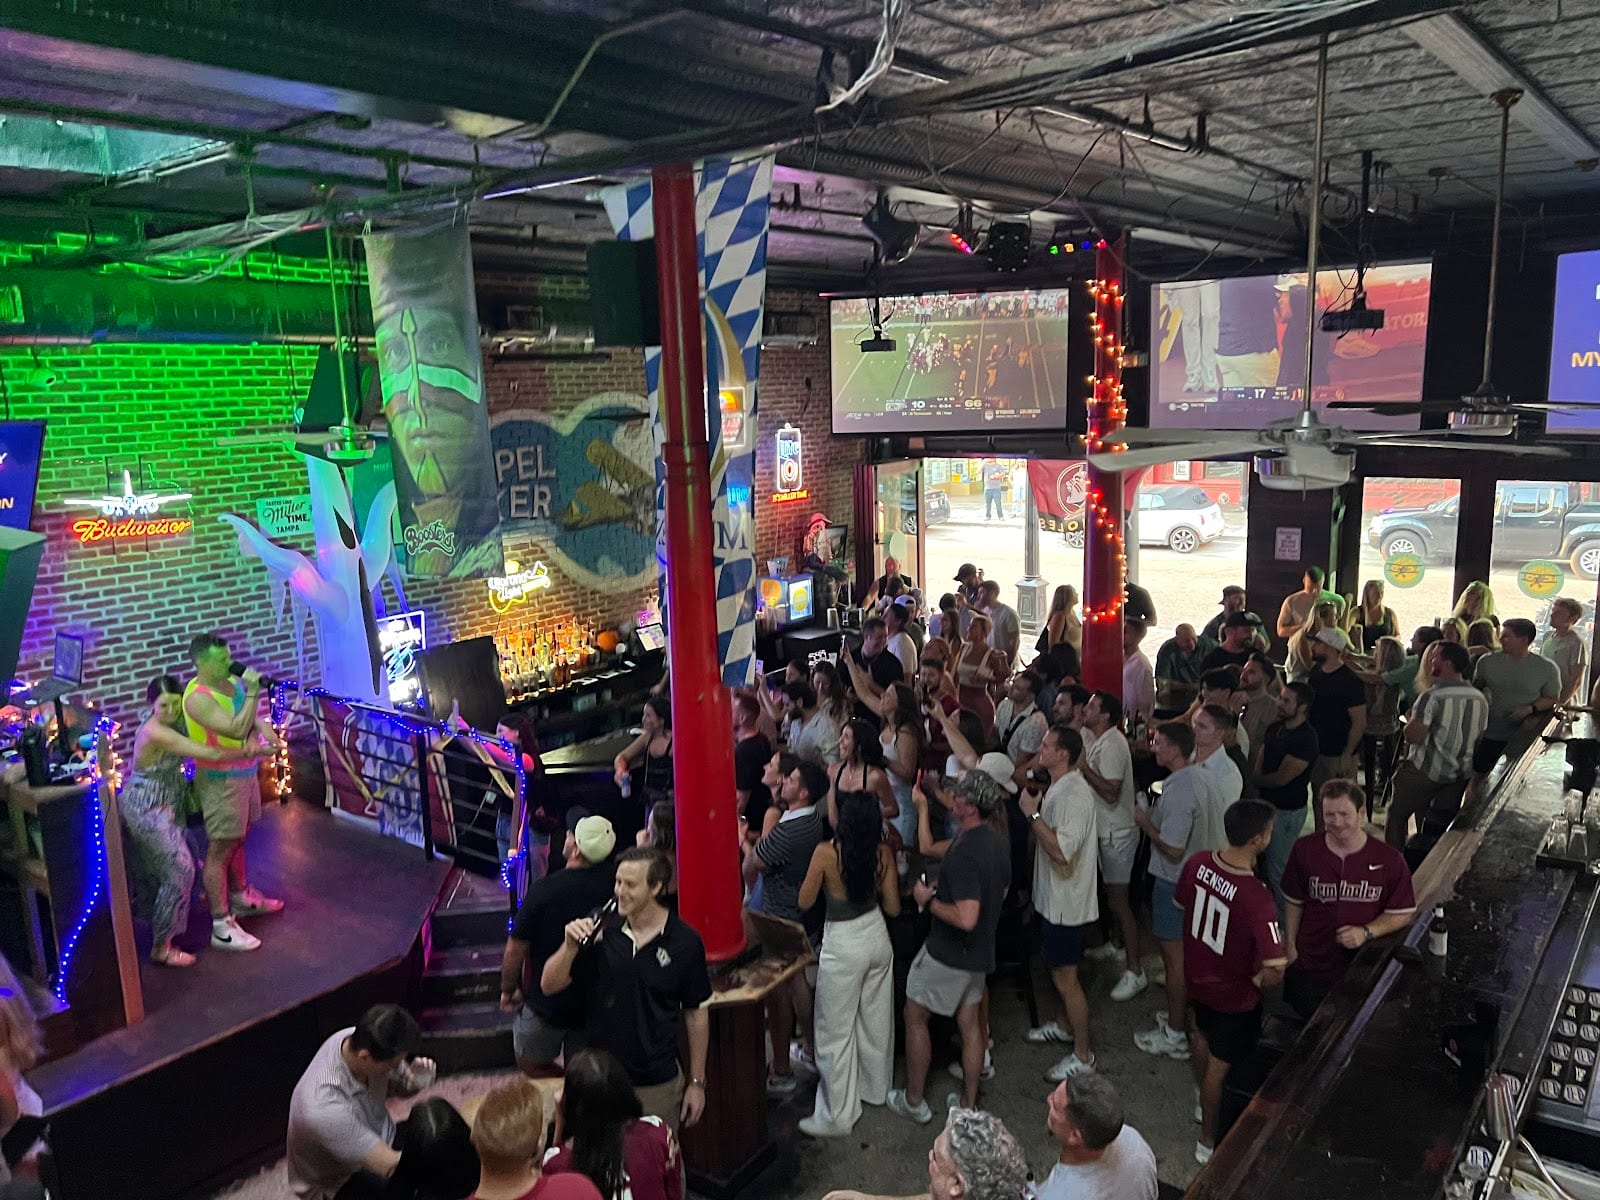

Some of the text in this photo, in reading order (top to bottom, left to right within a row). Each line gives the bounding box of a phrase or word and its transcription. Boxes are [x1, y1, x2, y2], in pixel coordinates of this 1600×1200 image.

[911, 400, 926, 409] 10
[1254, 388, 1266, 399] 17
[494, 444, 557, 483] PEL
[262, 501, 305, 526] Miller
[72, 517, 192, 543] Budweiser
[276, 524, 300, 534] TAMPA
[1196, 863, 1238, 903] BENSON
[1191, 882, 1230, 957] 10
